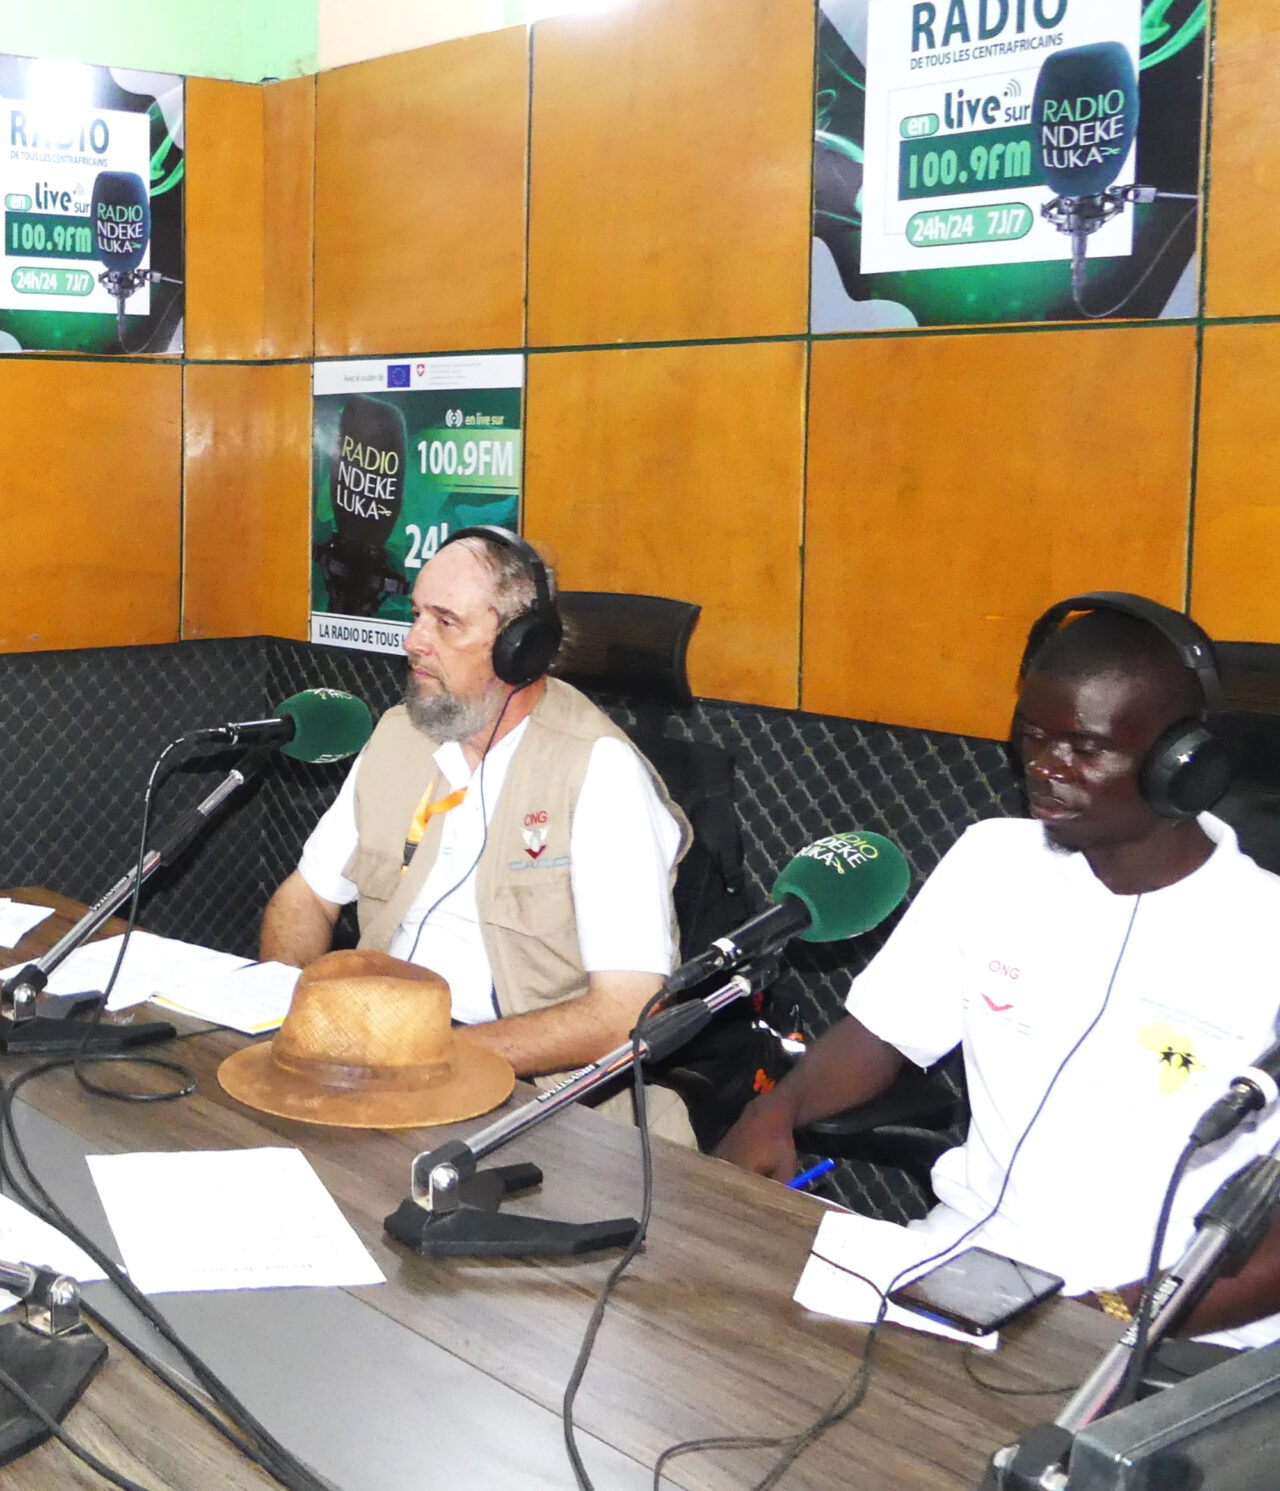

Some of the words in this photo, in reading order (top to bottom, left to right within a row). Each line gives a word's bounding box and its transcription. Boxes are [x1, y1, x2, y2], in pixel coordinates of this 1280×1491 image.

[911, 0, 1068, 52] RADIO
[910, 58, 923, 70] DE
[925, 52, 951, 67] TOUS
[953, 48, 970, 63] LES
[972, 32, 1064, 59] CENTRAFRICAINS
[907, 115, 930, 135] en
[1004, 104, 1031, 123] sur
[1042, 89, 1125, 123] RADIO
[10, 110, 109, 155] RIO
[1041, 114, 1125, 148] NDEKE
[1043, 146, 1103, 169] LUKA
[74, 201, 91, 213] sur
[97, 202, 143, 223] RADIO
[97, 220, 144, 239] NDEKE
[912, 213, 974, 242] 24h/24
[987, 208, 1026, 235] 7J/7
[98, 236, 133, 253] LUKA
[16, 271, 58, 290] 24h/24
[465, 415, 477, 426] en
[477, 412, 491, 426] live
[491, 413, 505, 426] sur
[341, 435, 400, 476] RADIO
[417, 440, 514, 477] 100.9FM
[337, 461, 398, 500] NDEKE
[336, 485, 380, 521] LUKA
[319, 623, 330, 639] LA
[331, 625, 360, 642] RADIO
[361, 629, 373, 644] DE
[374, 630, 399, 648] TOUS
[524, 810, 548, 827] ONG
[813, 836, 868, 869] DEKE
[988, 959, 1020, 981] ONG
